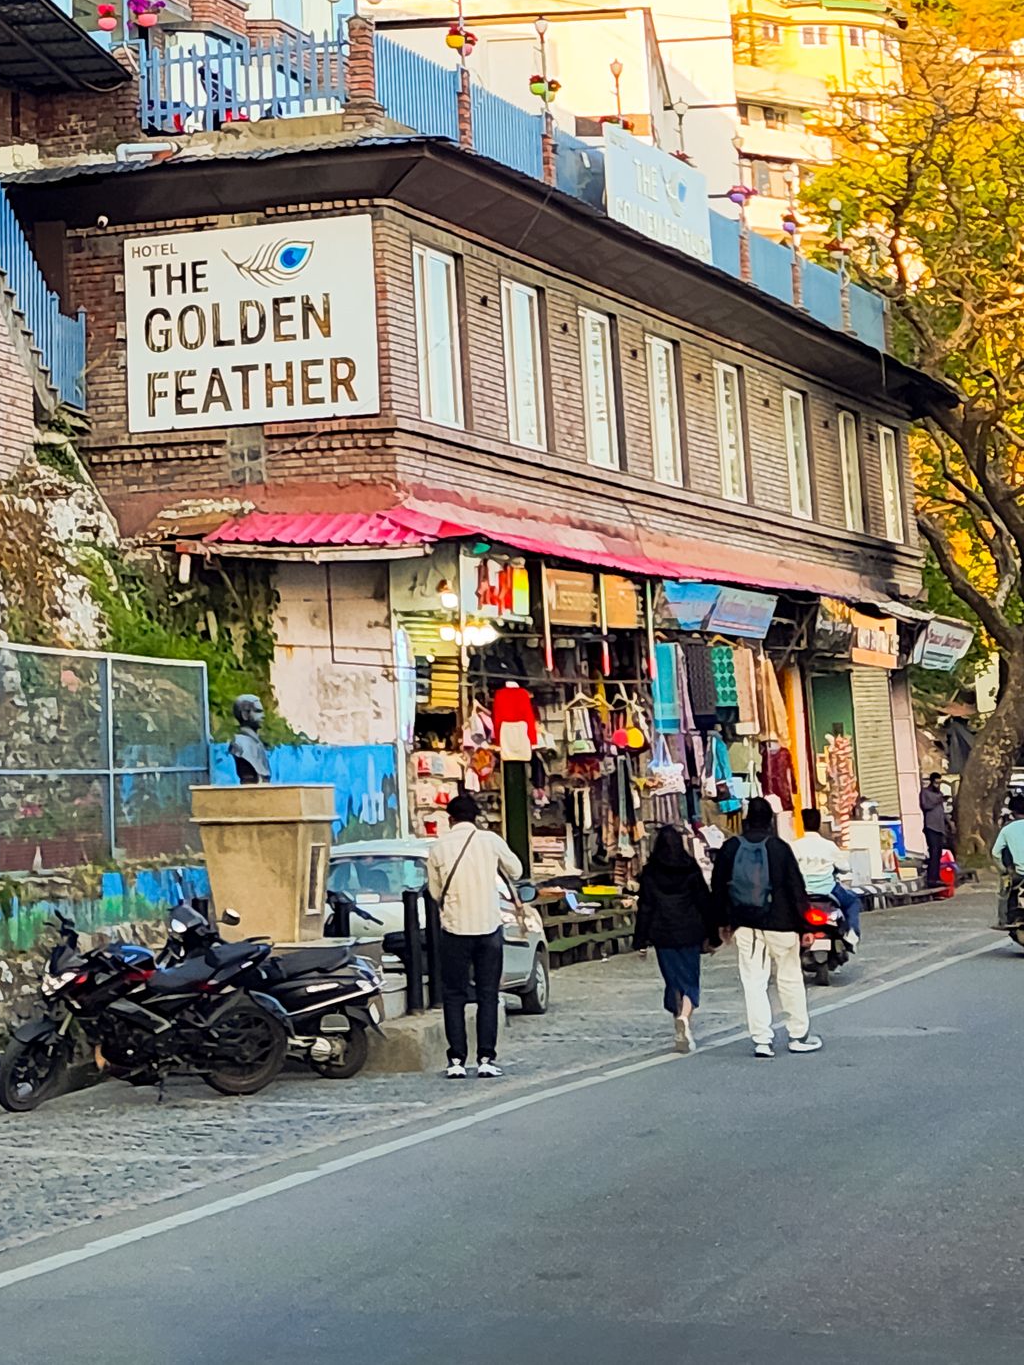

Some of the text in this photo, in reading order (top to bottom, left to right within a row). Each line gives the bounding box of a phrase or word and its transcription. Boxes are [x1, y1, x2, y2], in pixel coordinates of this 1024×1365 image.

[632, 157, 658, 202] THE
[131, 242, 178, 259] HOTEL
[143, 260, 209, 297] THE
[144, 292, 332, 353] GOLDEN
[147, 356, 358, 418] FEATHER
